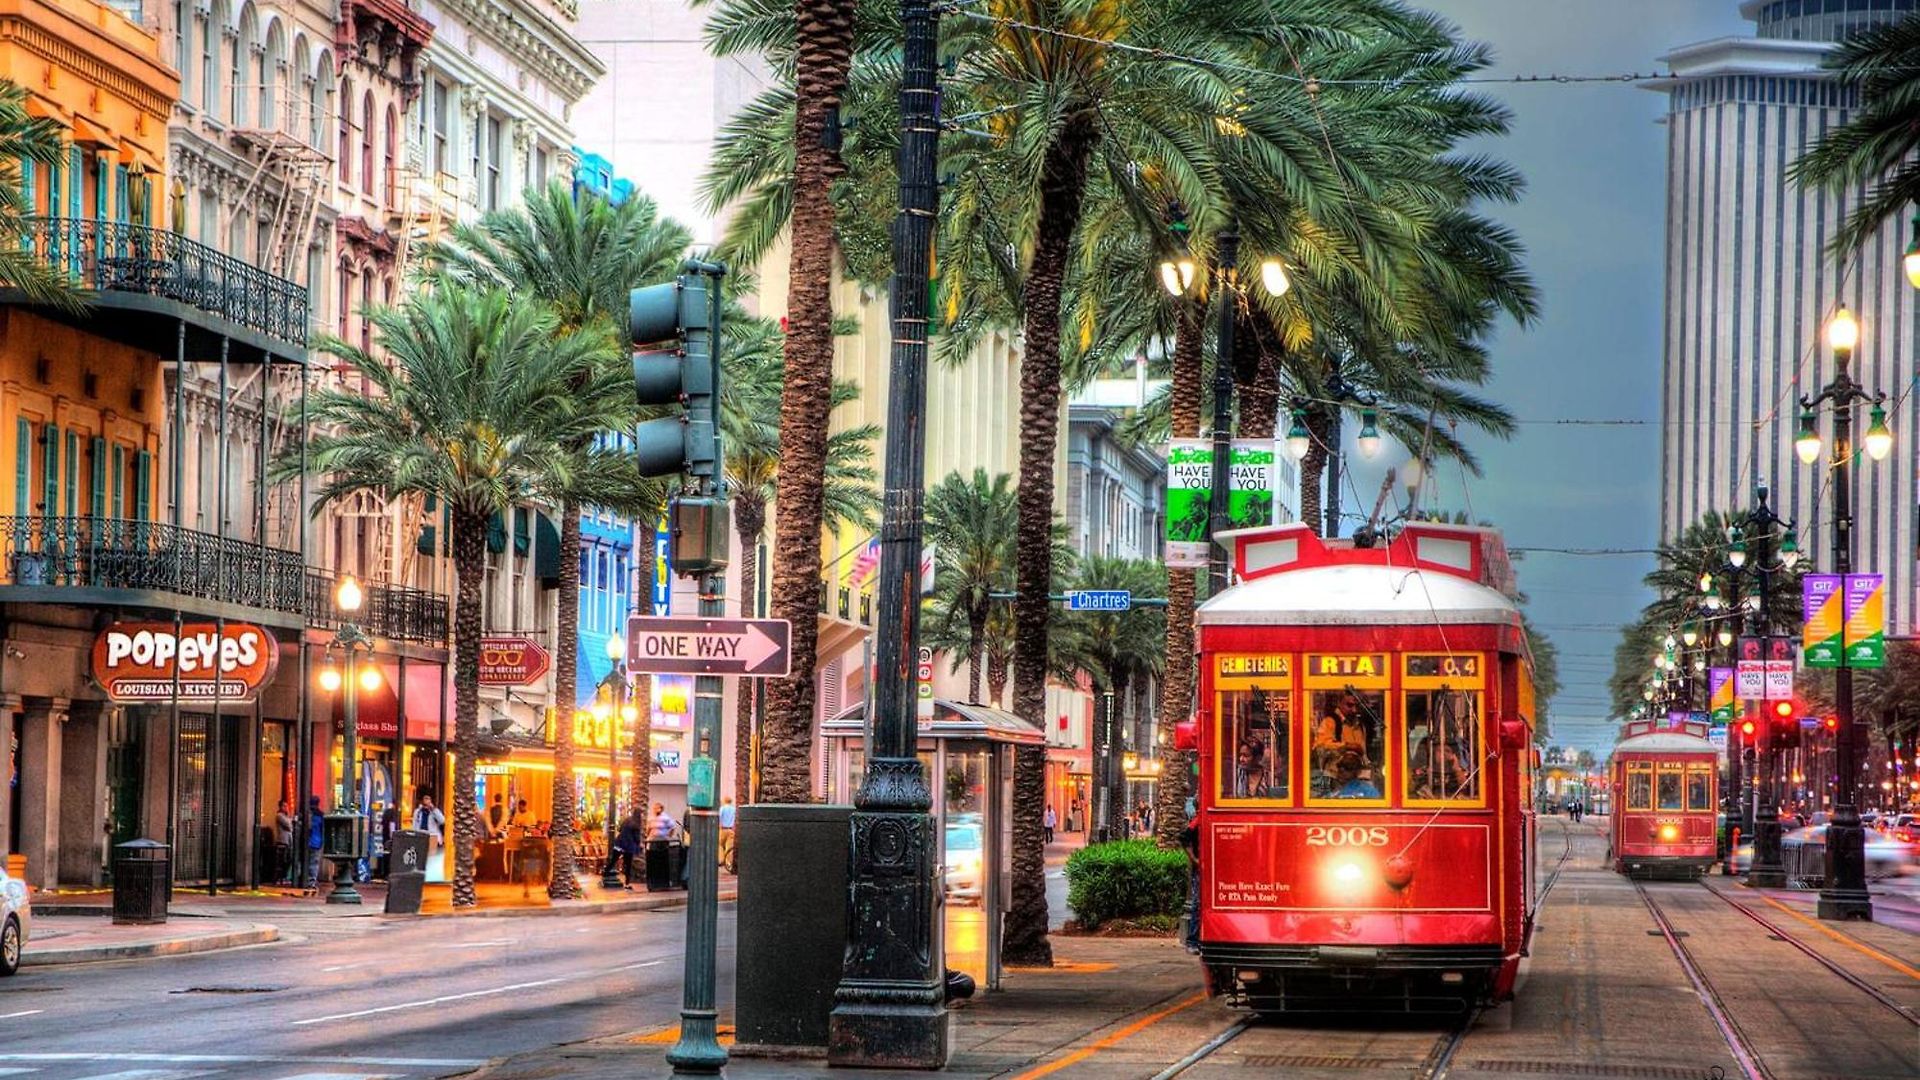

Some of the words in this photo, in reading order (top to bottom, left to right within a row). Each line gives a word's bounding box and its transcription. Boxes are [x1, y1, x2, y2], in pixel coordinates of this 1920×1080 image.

[1174, 466, 1210, 478] HAVE
[1230, 467, 1266, 479] HAVE
[1181, 478, 1211, 490] YOU
[1237, 480, 1267, 491] YOU
[1078, 592, 1128, 609] Chartres
[645, 635, 689, 657] ONE
[696, 636, 742, 657] WAY
[1221, 655, 1289, 674] CEMETERIES
[1320, 656, 1377, 674] RTA
[185, 684, 242, 695] KITCEN
[1306, 826, 1390, 848] 2008
